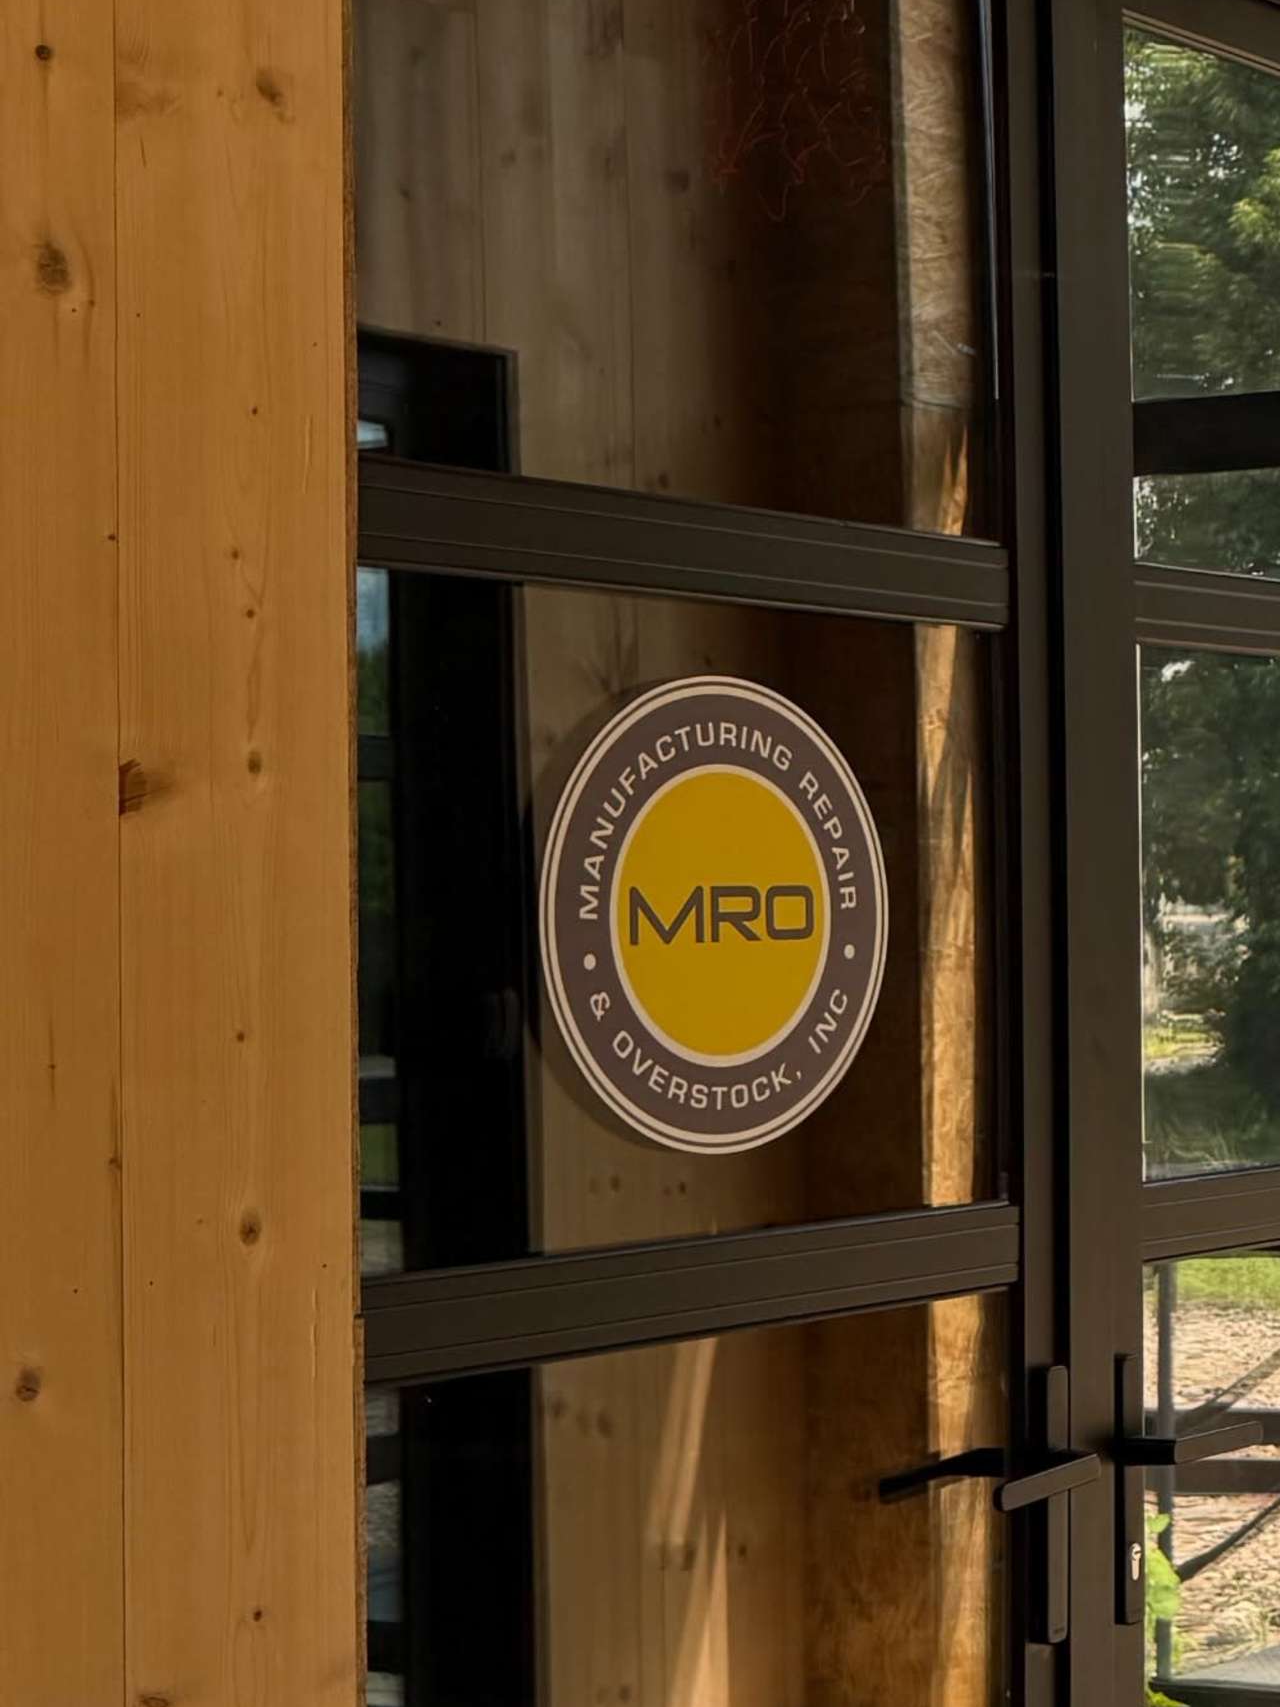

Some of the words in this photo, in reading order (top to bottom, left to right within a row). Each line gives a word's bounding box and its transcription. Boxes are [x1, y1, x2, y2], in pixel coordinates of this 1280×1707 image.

[579, 722, 793, 921] MANUFACTURING
[799, 772, 858, 911] REPAIR
[628, 885, 815, 946] MRO
[590, 991, 611, 1021] &
[612, 1031, 803, 1110] OVERSTOCK,
[808, 989, 848, 1055] INC
